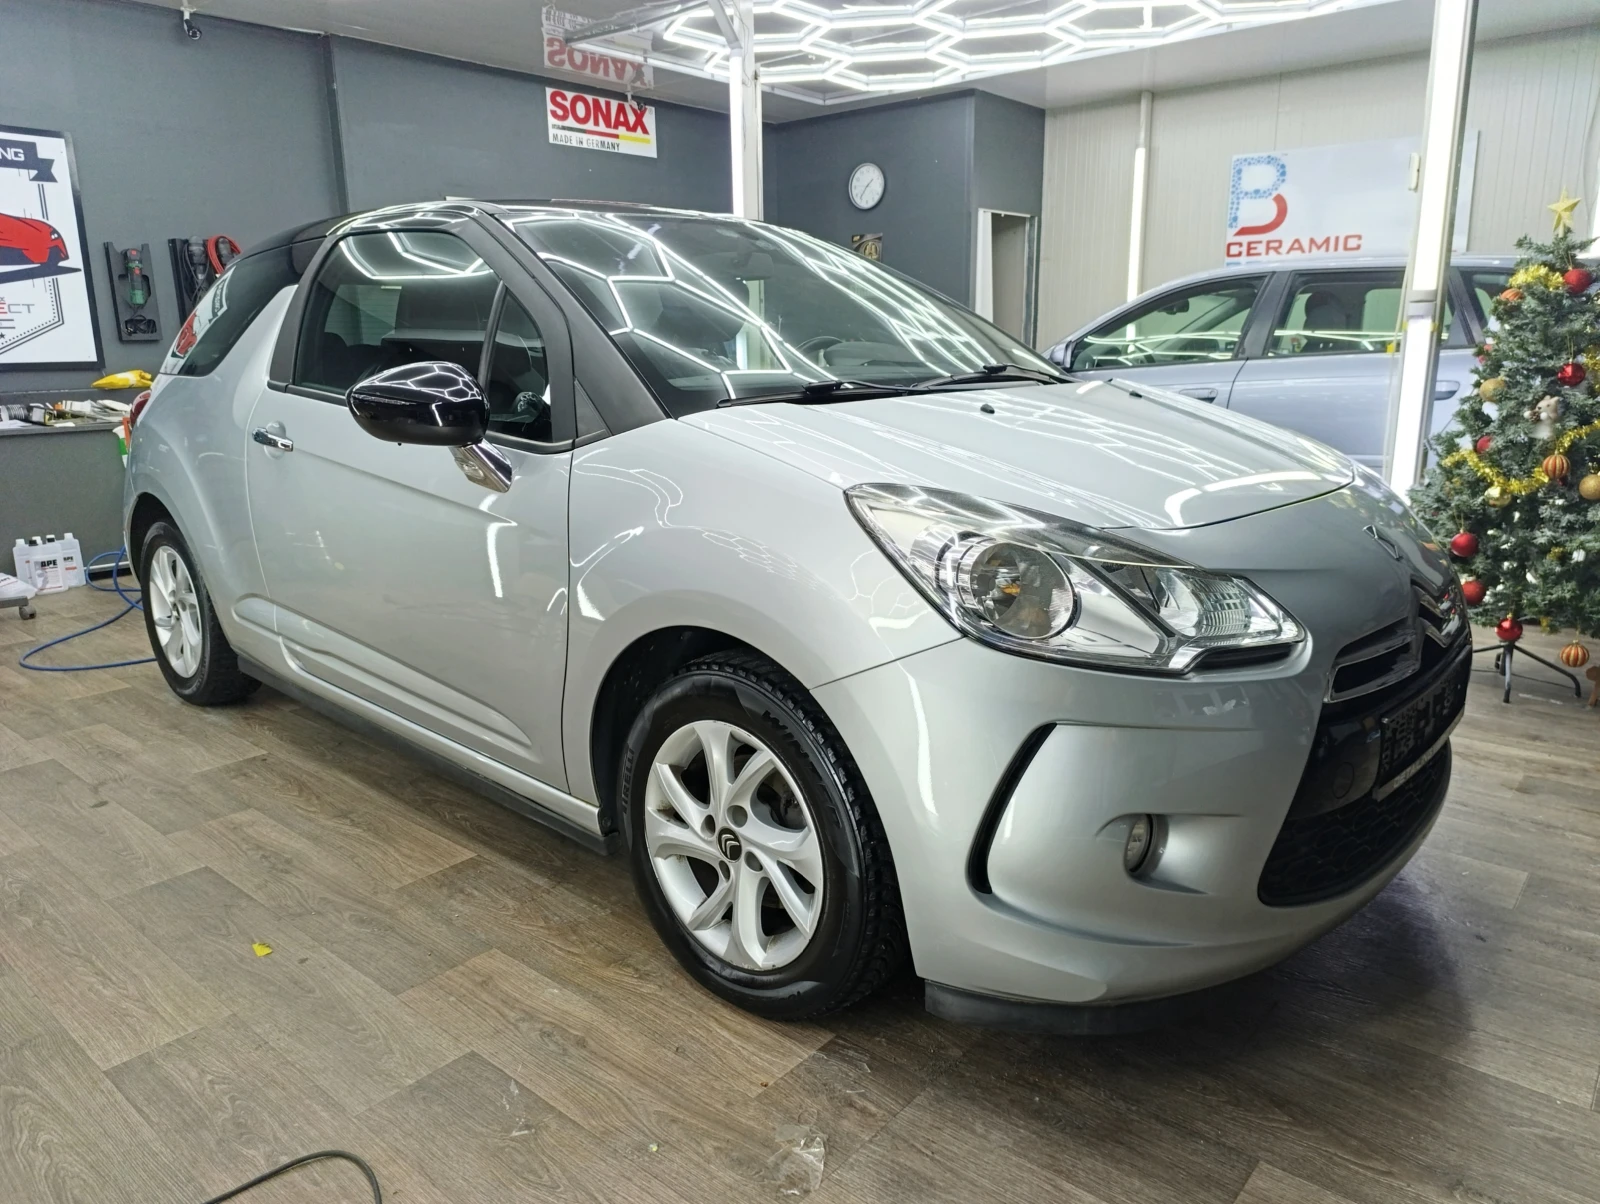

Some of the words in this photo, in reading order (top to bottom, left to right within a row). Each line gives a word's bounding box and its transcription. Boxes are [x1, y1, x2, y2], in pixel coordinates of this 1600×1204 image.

[549, 90, 650, 135] SONAX
[552, 133, 573, 145] MADE
[575, 136, 584, 146] IN
[586, 138, 620, 152] GERMANY
[1225, 234, 1363, 258] CERAMIC
